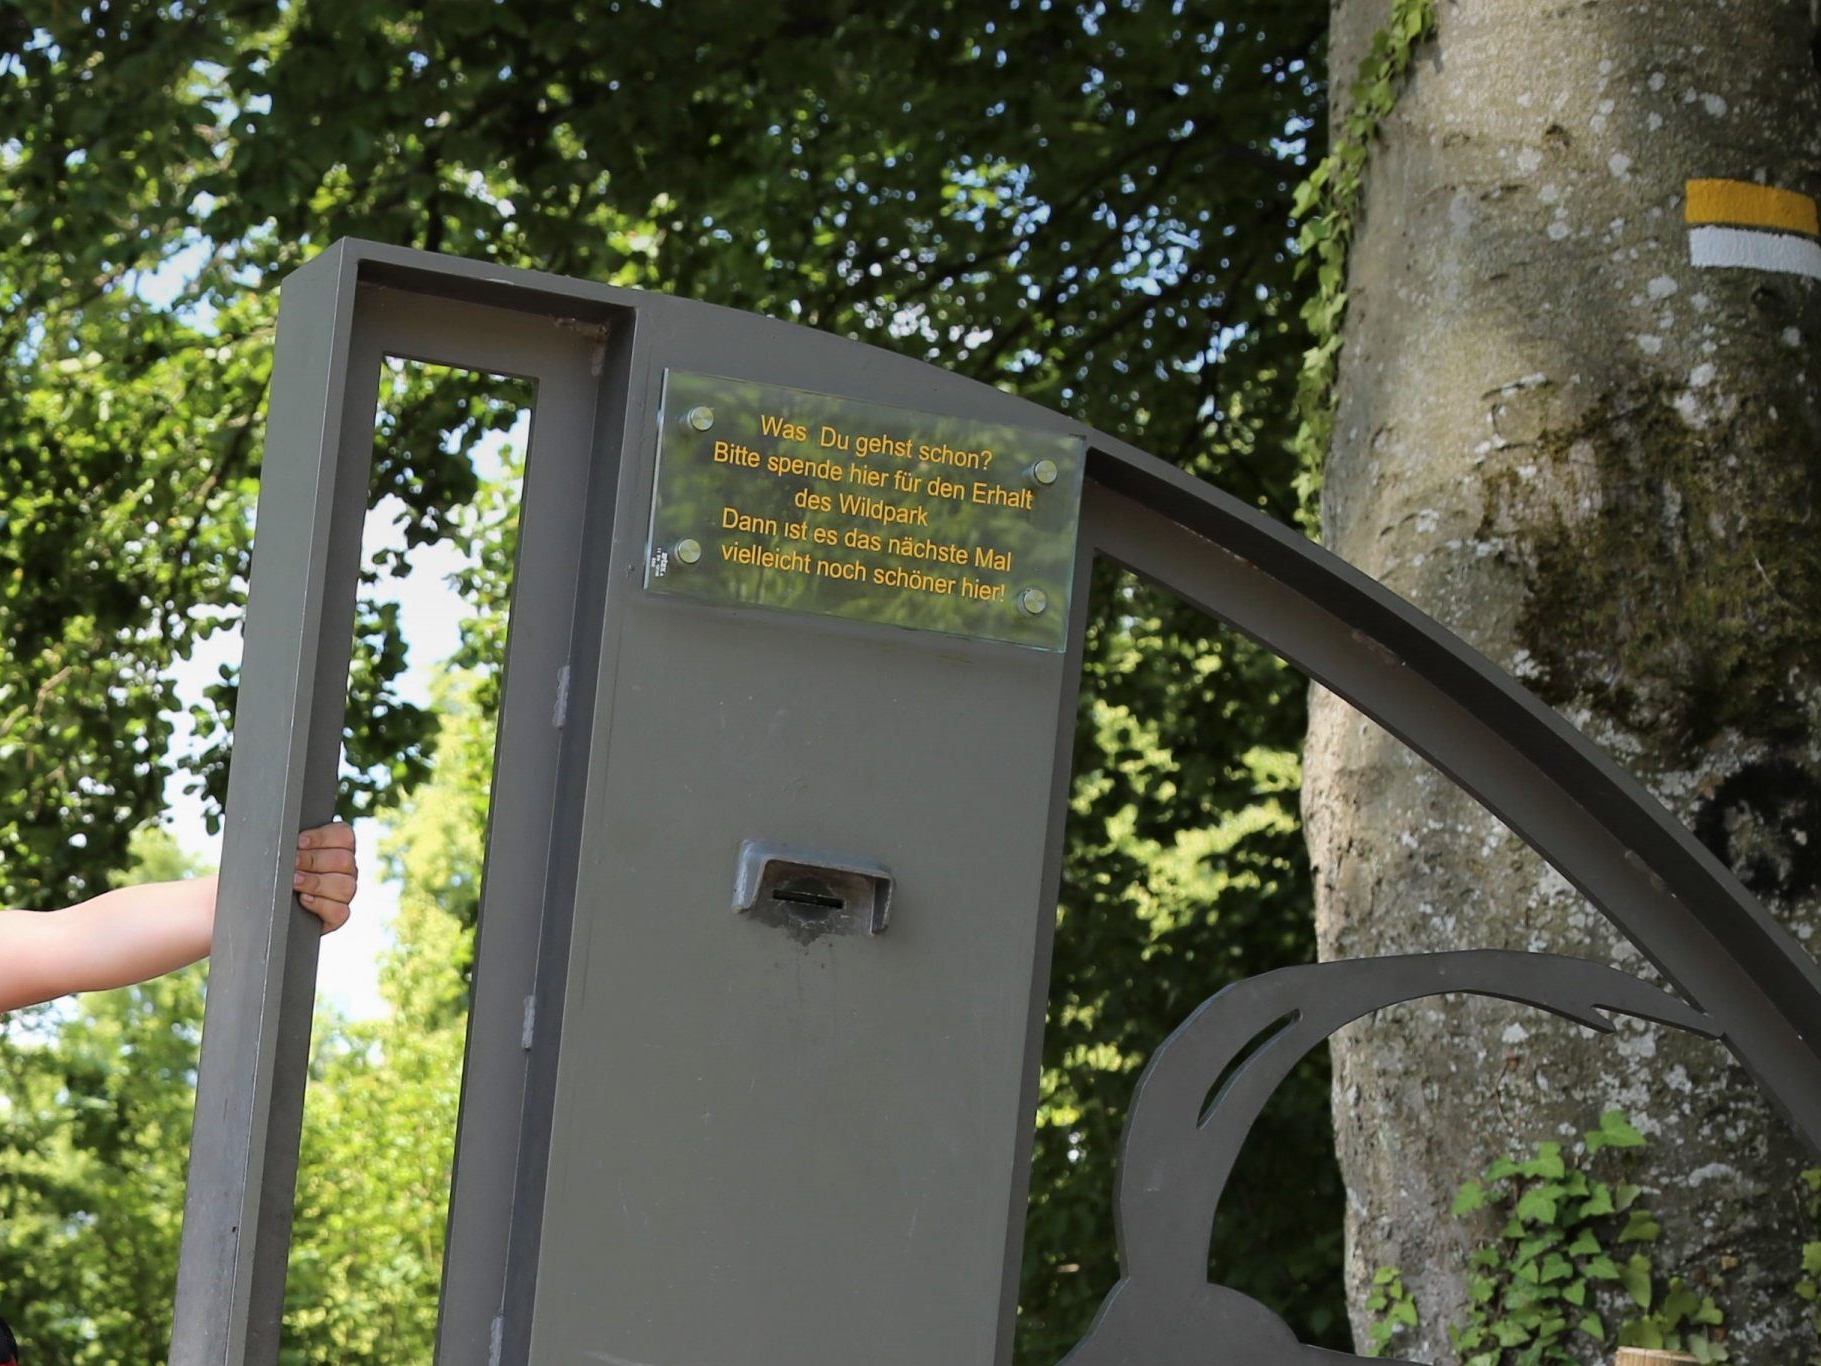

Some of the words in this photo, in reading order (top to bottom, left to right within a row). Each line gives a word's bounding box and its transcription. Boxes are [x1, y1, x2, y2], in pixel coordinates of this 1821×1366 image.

[760, 414, 807, 442] Was
[820, 426, 849, 450] Du
[855, 434, 913, 458] gehst
[918, 444, 993, 471] schon?
[713, 441, 761, 468] Bitte
[766, 453, 843, 481] spende
[849, 464, 889, 487] hier
[894, 470, 922, 493] für
[927, 477, 965, 500] den
[972, 483, 1033, 510] Erhalt
[795, 488, 832, 511] des
[839, 493, 929, 527] Wildpark
[721, 507, 777, 536] Dann
[784, 521, 808, 541] ist
[813, 527, 838, 545] es
[844, 528, 882, 551] das
[888, 536, 969, 565] nächste
[974, 547, 1012, 572] Mal
[721, 541, 811, 574] vielleicht
[816, 558, 867, 581] noch
[872, 566, 956, 595] schöner
[960, 577, 1006, 602] hier!
